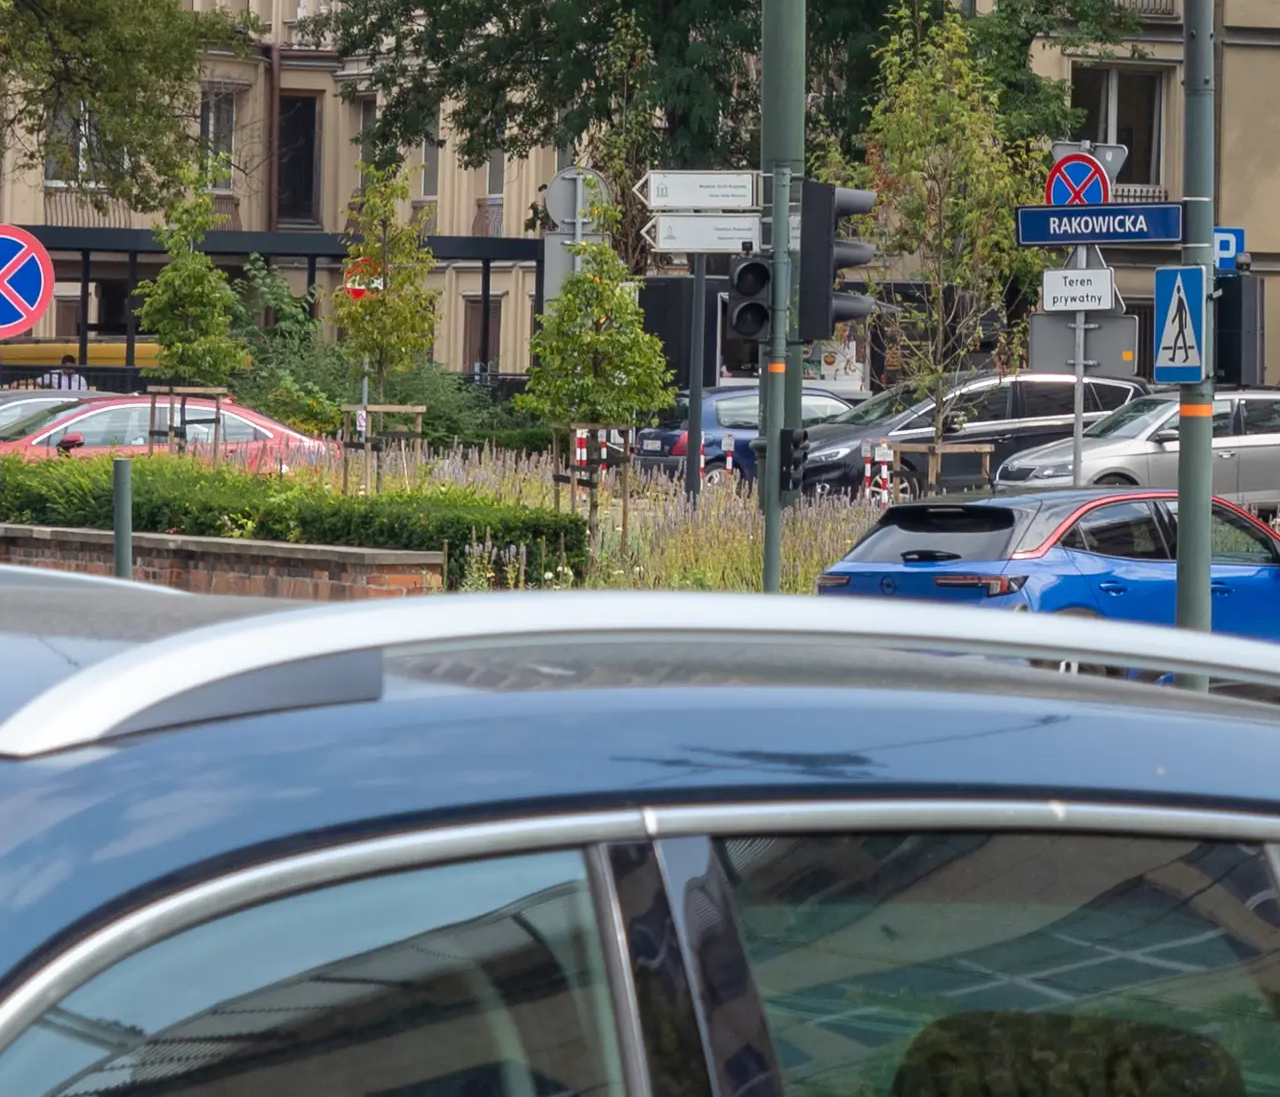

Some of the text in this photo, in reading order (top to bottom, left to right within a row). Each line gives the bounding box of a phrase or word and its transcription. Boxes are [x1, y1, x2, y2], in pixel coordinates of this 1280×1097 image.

[1049, 214, 1148, 235] RAKOWICKA
[1214, 232, 1236, 270] P
[1062, 275, 1093, 287] Teren
[1052, 292, 1103, 307] prywatny
